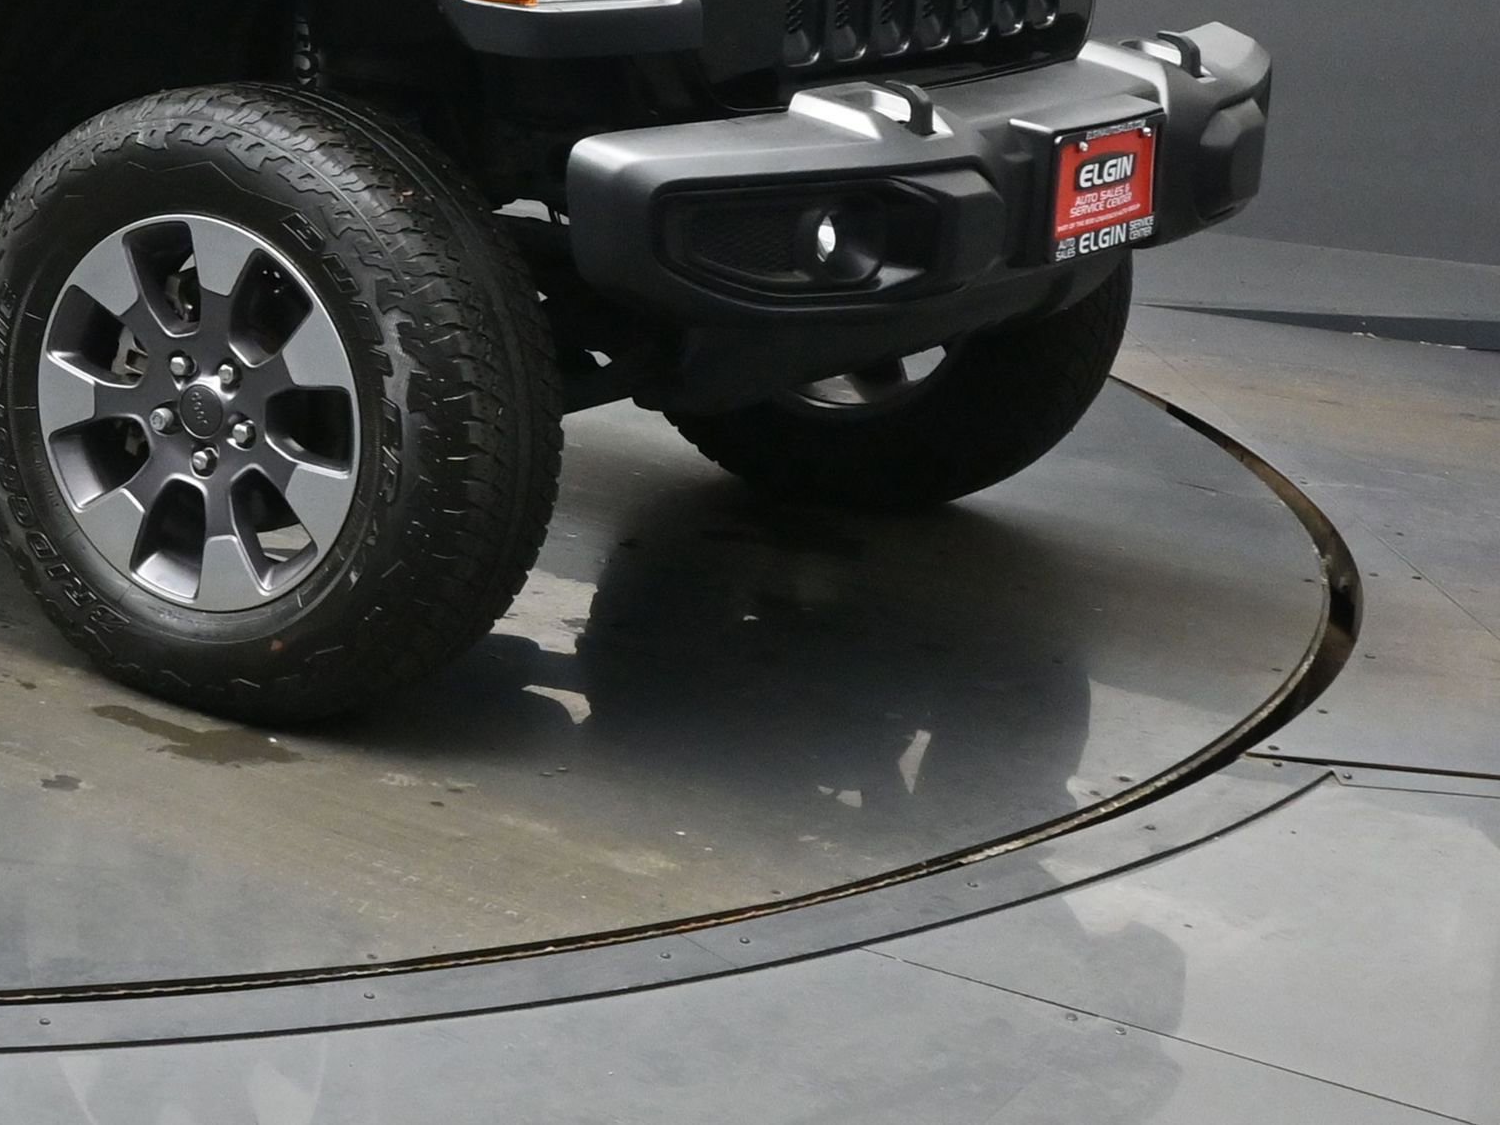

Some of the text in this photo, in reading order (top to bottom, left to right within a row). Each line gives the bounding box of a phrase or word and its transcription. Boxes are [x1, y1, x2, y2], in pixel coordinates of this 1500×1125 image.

[1079, 154, 1134, 188] ELGIN
[1075, 192, 1098, 206] AUTO
[1099, 185, 1124, 200] SALES
[1069, 201, 1105, 218] SERVICE
[1106, 192, 1132, 209] CENTER
[1128, 215, 1154, 230] SERVICE
[1079, 223, 1127, 254] ELGIN
[1128, 226, 1153, 240] CENTER
[1058, 237, 1076, 249] AUTO
[1055, 247, 1076, 262] SALES
